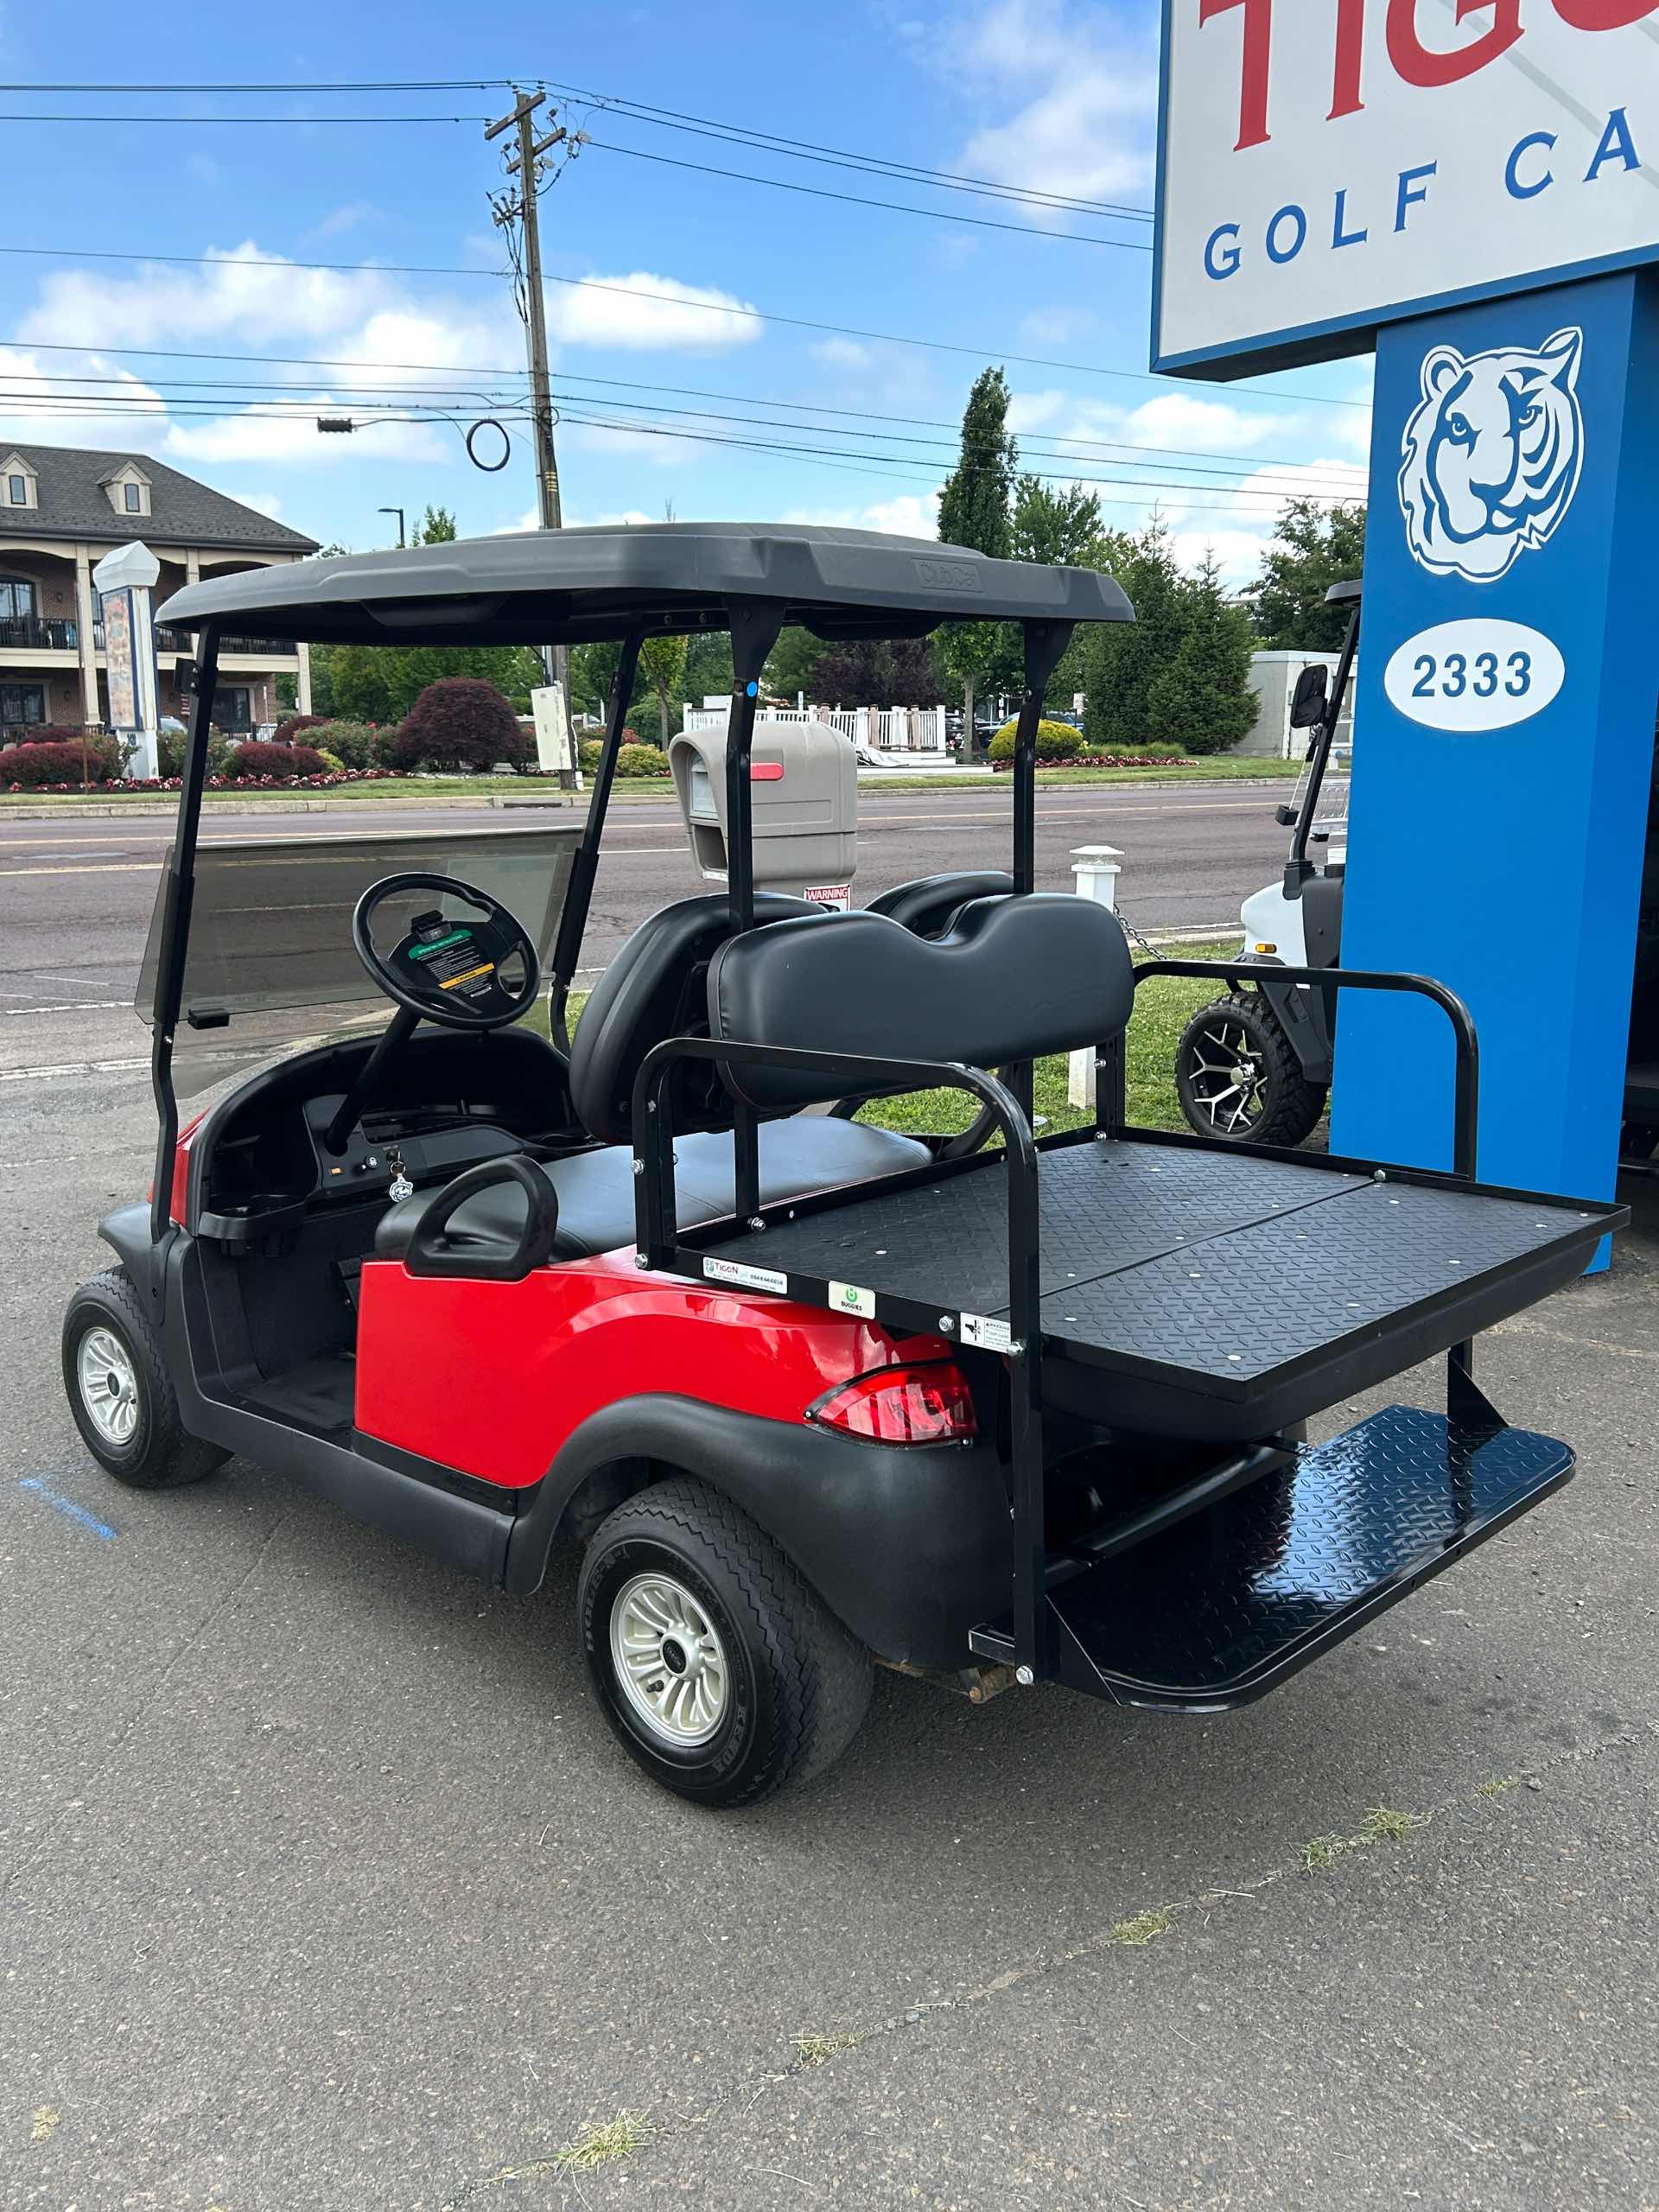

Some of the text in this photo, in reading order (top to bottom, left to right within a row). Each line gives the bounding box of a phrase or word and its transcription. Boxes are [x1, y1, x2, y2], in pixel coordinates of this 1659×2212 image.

[1204, 106, 1642, 281] GOLF CA
[1411, 651, 1531, 698] 2333
[806, 887, 848, 900] WARNING
